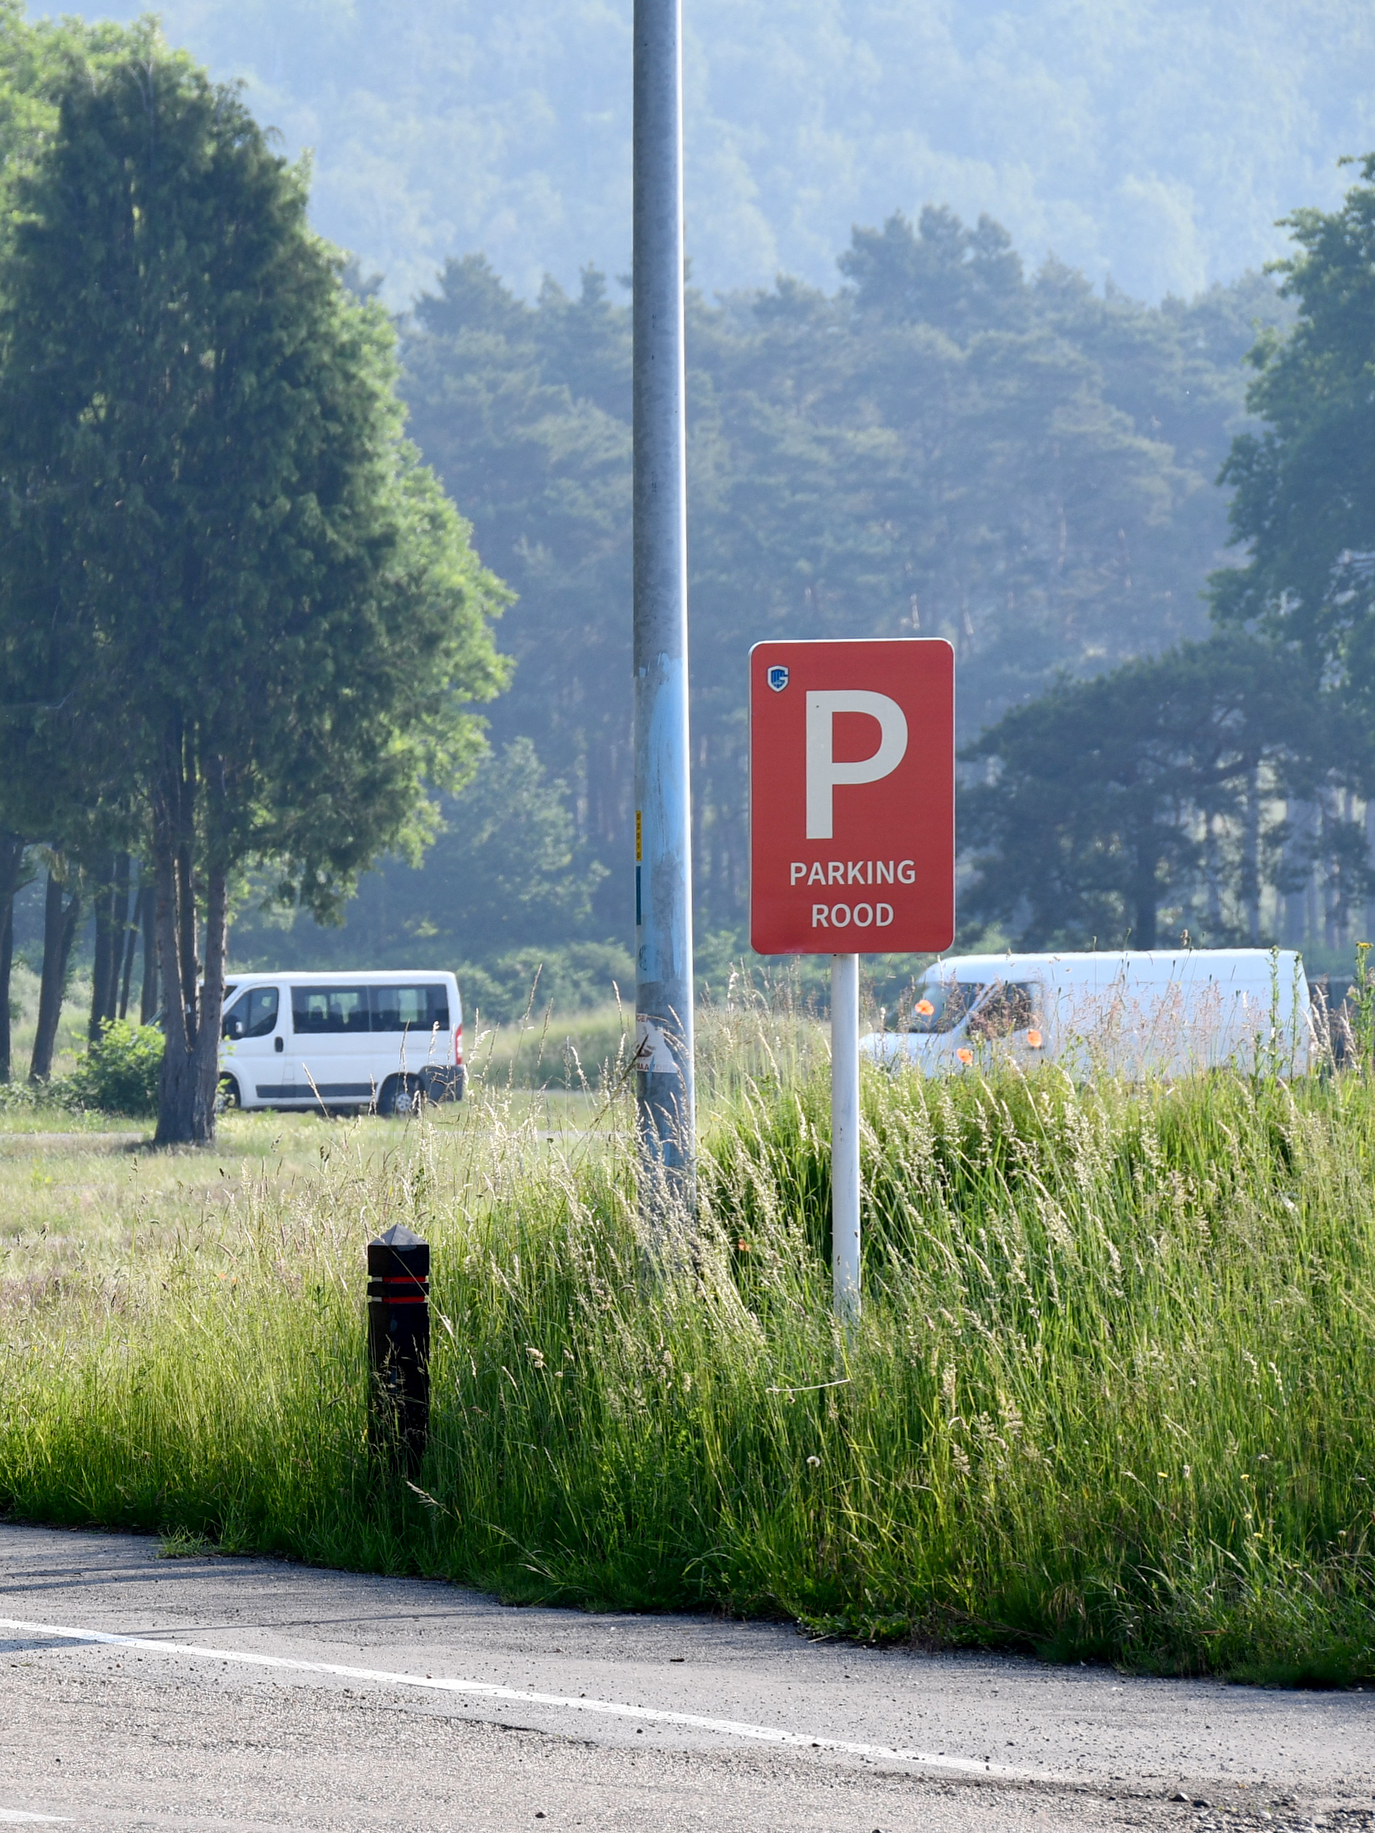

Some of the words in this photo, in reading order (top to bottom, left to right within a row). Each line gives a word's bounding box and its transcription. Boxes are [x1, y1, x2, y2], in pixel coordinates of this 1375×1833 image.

[806, 690, 908, 839] P
[790, 860, 916, 886] PARKING
[811, 903, 894, 928] ROOD
